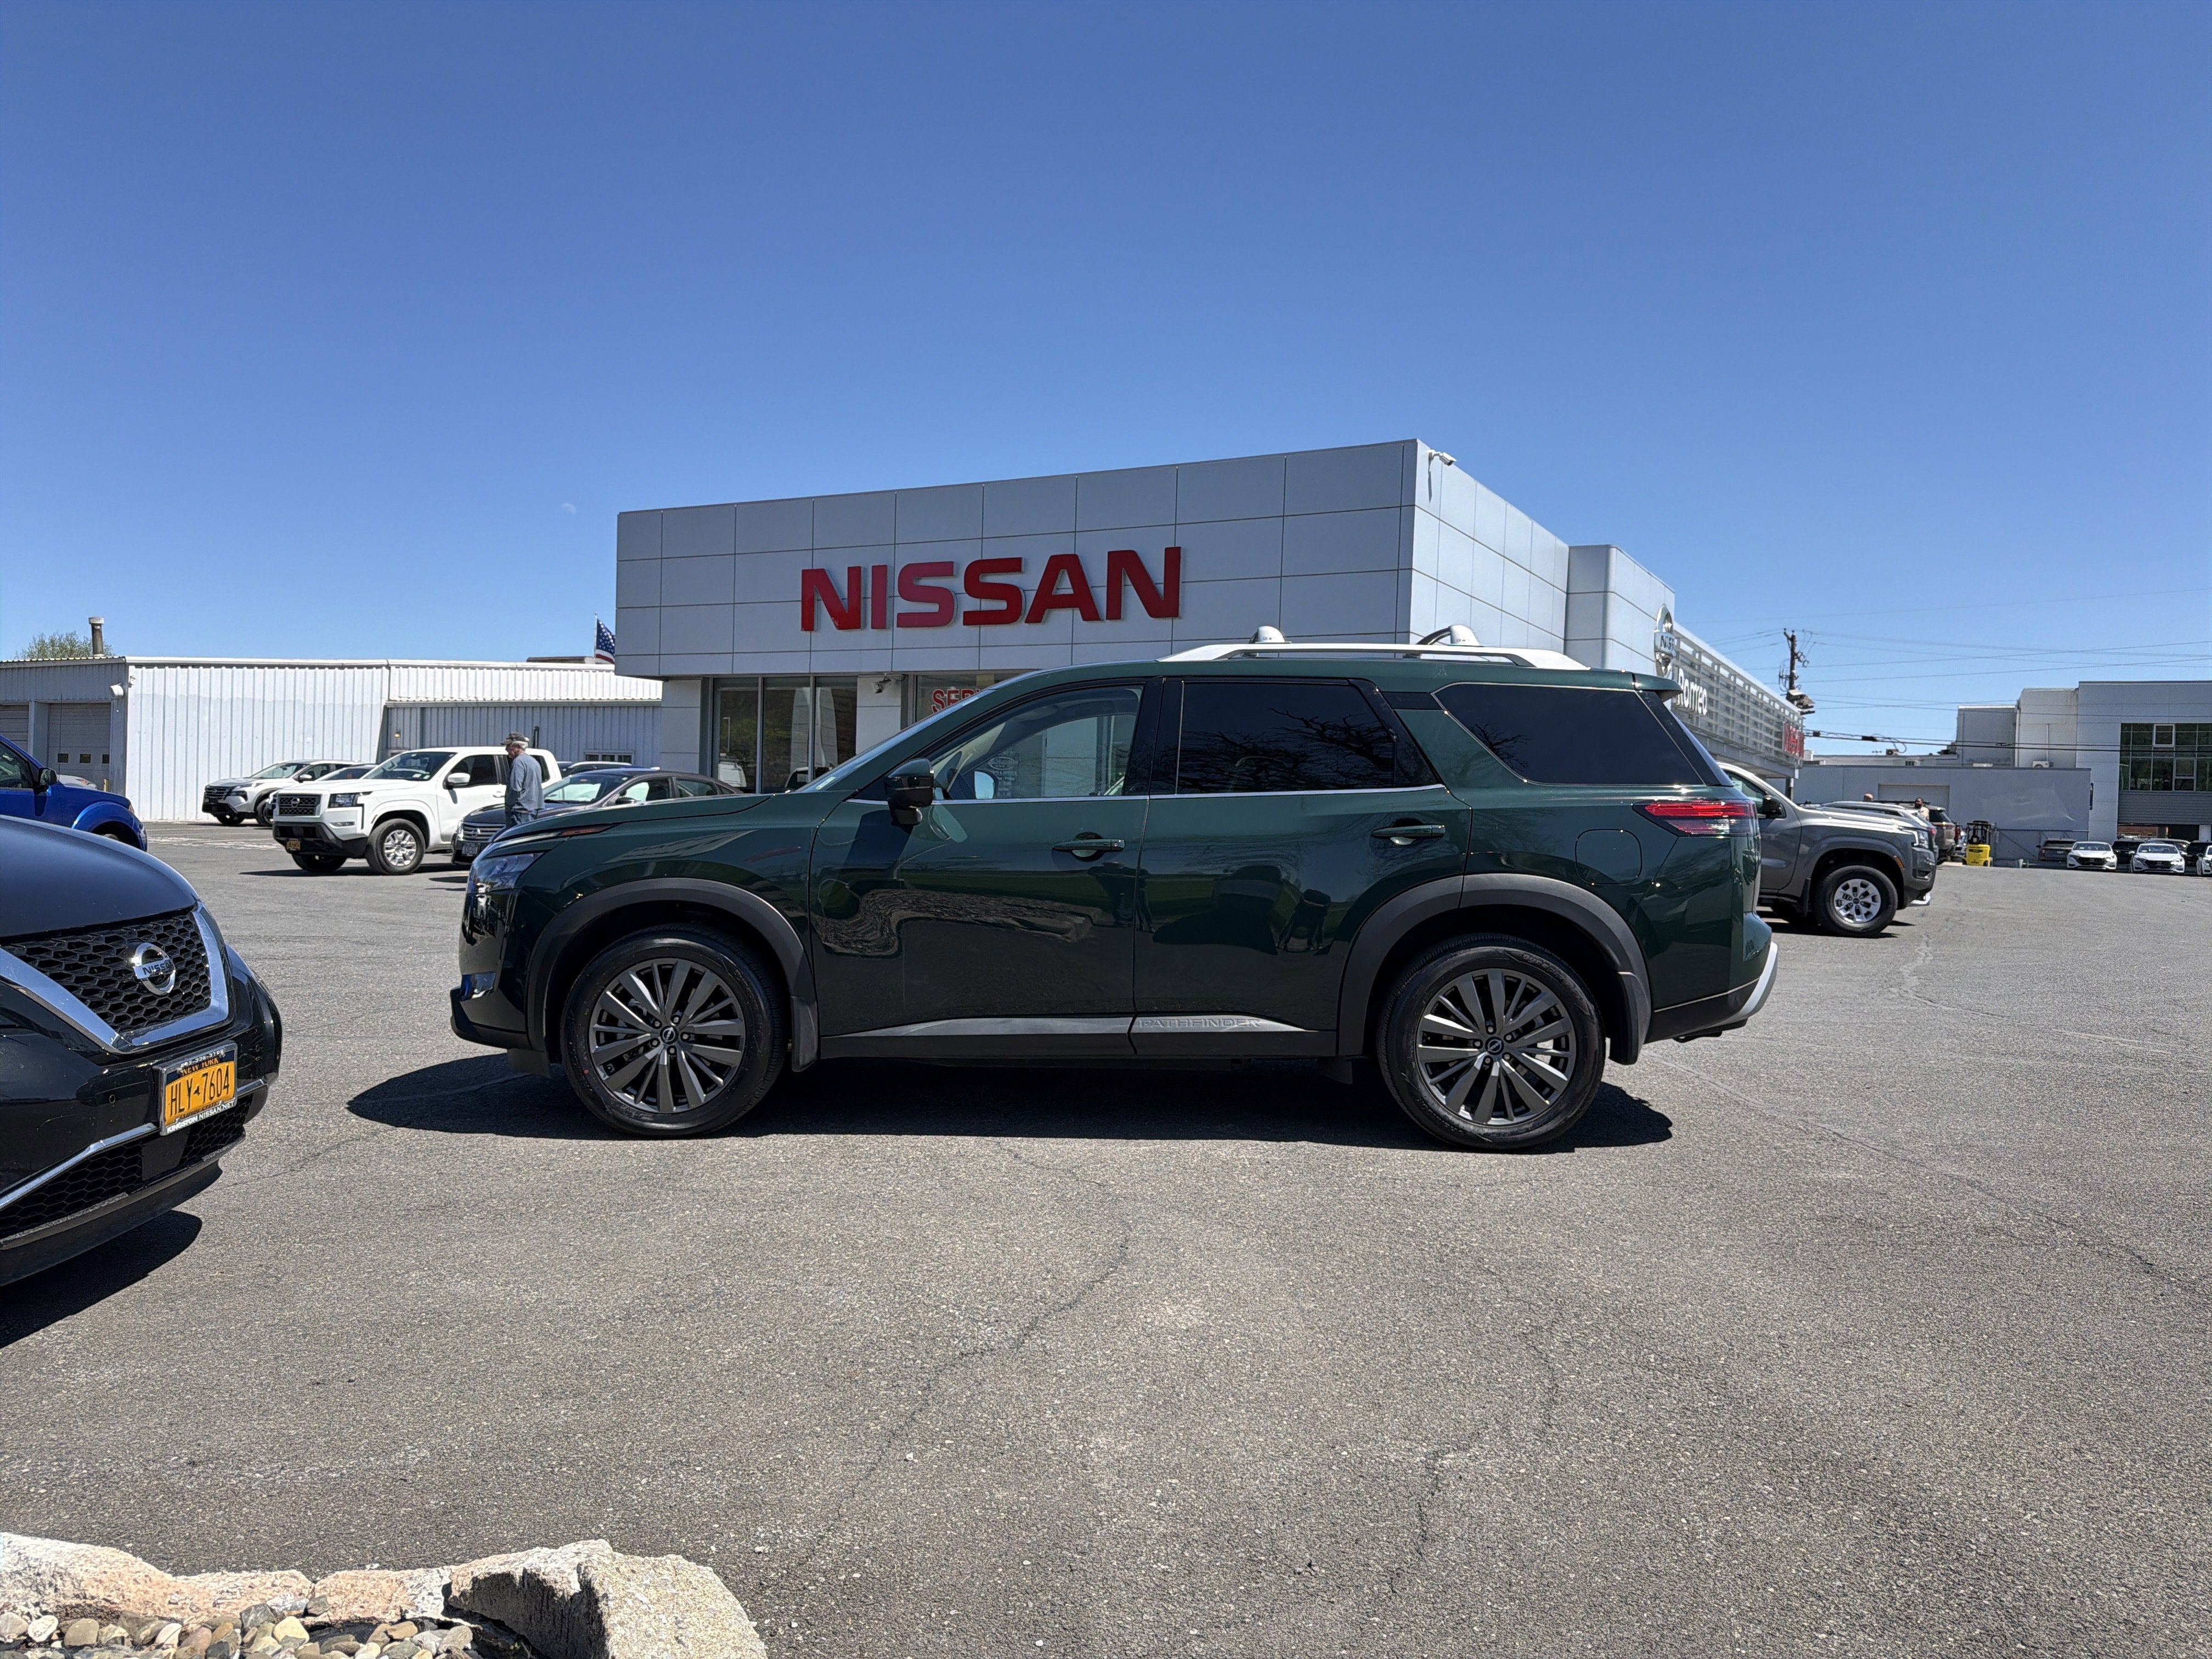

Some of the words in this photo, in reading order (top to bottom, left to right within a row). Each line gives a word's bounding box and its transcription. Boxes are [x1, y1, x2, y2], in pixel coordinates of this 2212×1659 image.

[801, 546, 1181, 631] NISSAN
[1676, 668, 1707, 715] Romeo
[1139, 1019, 1260, 1028] PATHFINDER
[182, 1064, 199, 1076] NEW
[170, 1077, 193, 1117] HLY
[201, 1063, 229, 1103] 7604
[167, 1115, 198, 1133] KINGSTON
